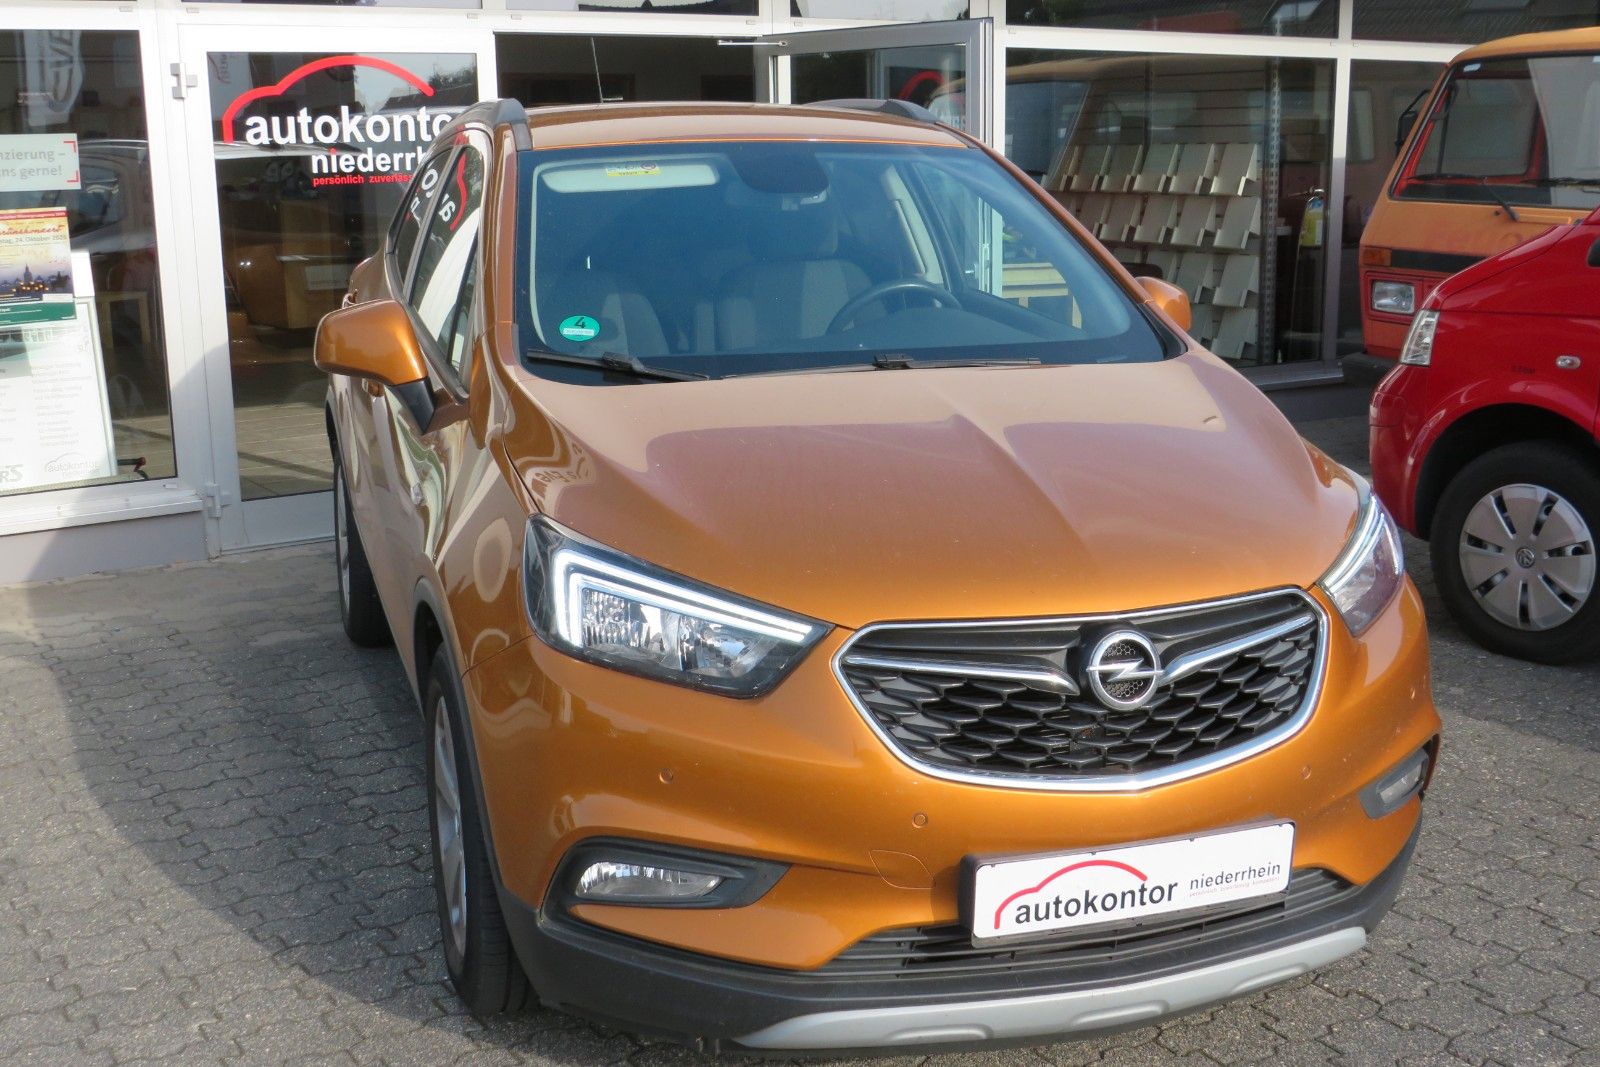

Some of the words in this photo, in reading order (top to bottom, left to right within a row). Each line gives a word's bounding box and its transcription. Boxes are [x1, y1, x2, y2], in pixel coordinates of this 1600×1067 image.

[20, 165, 63, 180] gerne!
[313, 174, 365, 187] persönlich
[574, 316, 586, 329] 4
[1015, 881, 1178, 924] autokontor
[1190, 861, 1281, 891] niederrhein
